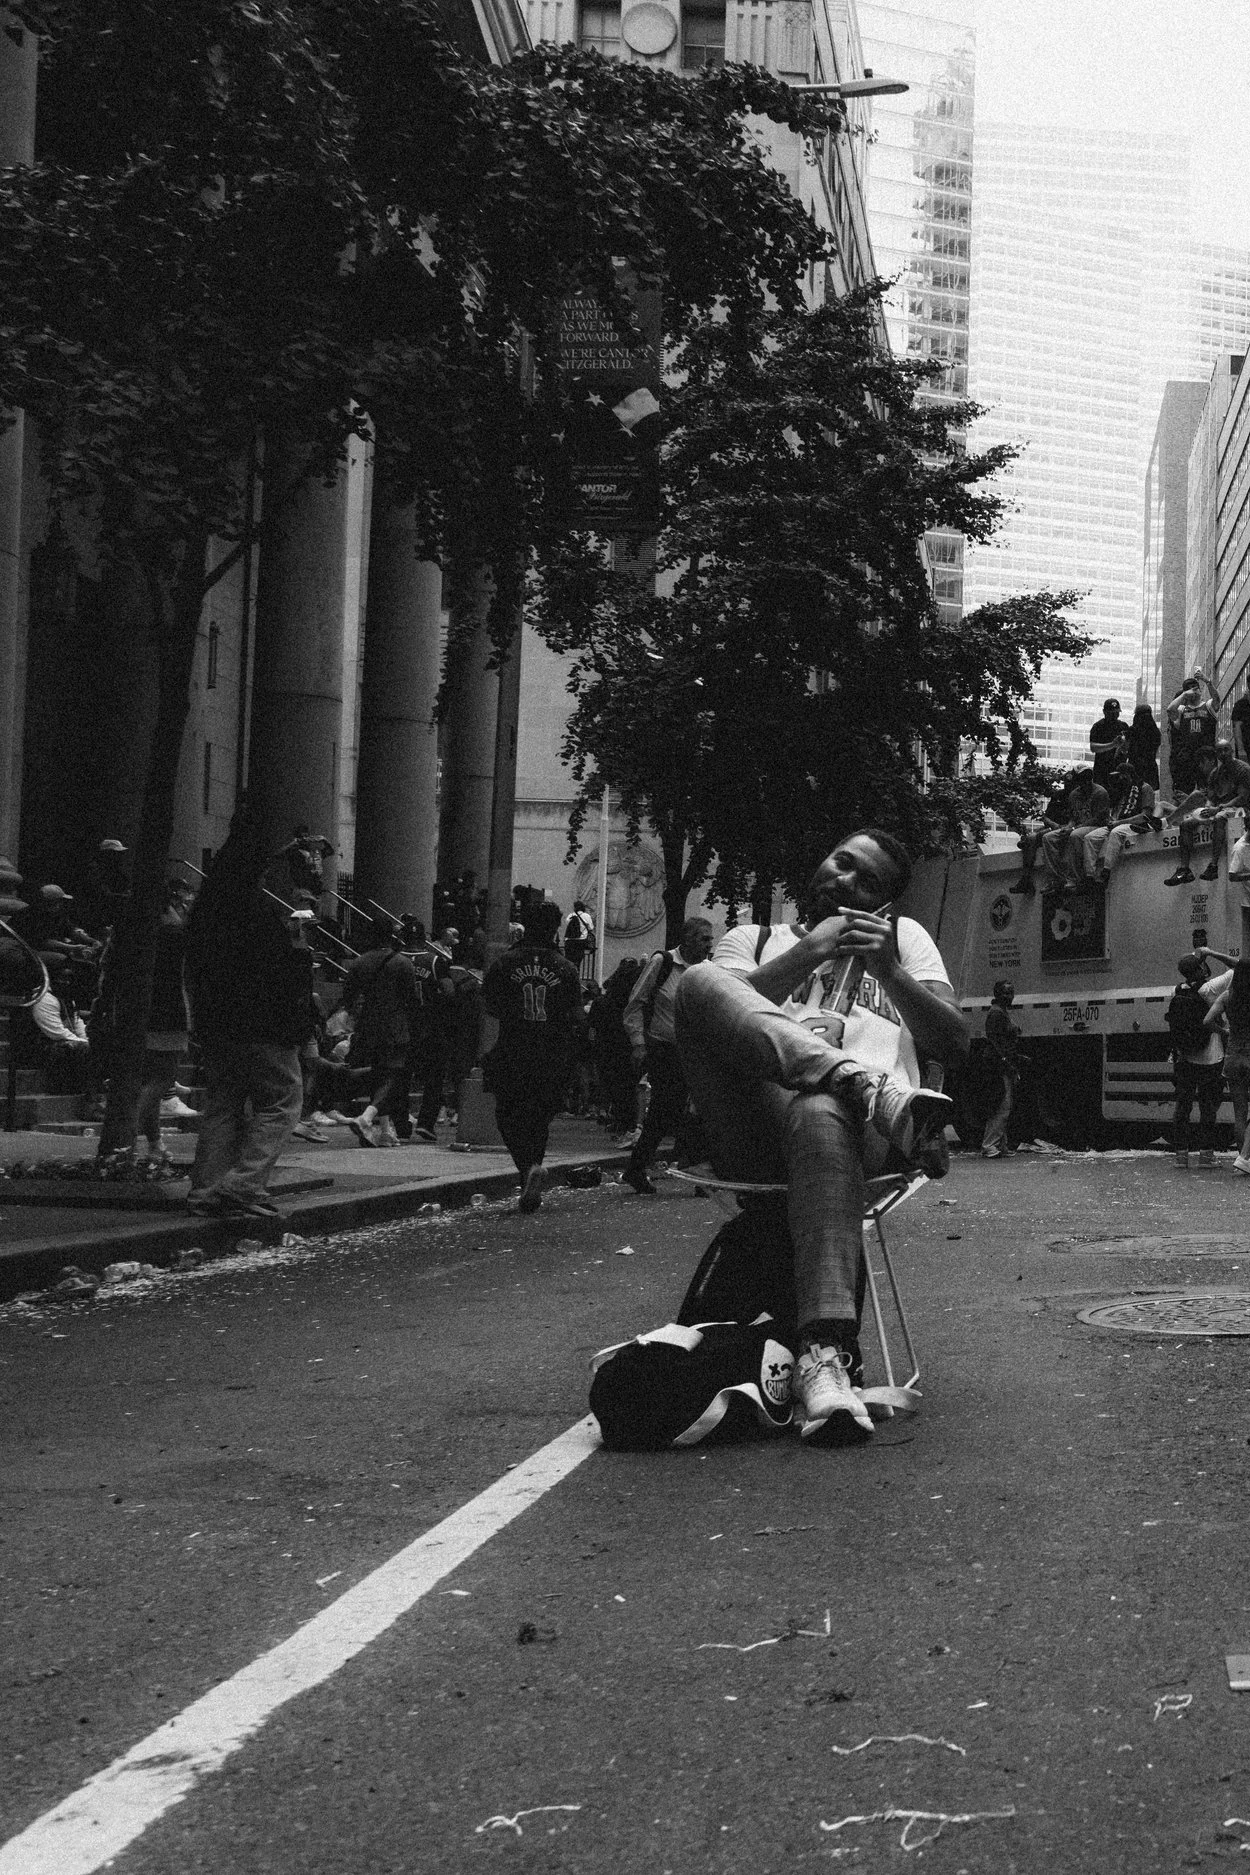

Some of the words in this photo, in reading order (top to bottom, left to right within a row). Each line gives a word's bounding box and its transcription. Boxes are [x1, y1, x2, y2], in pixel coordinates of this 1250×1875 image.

[560, 299, 601, 310] ALWAY
[571, 310, 599, 321] PART
[560, 321, 576, 332] AS
[577, 321, 597, 332] WE
[561, 359, 634, 370] ITZGERALD.
[989, 960, 1003, 969] NEW
[1003, 959, 1022, 968] YORK
[522, 982, 547, 1022] 11
[1063, 1006, 1100, 1022] 25FA-070
